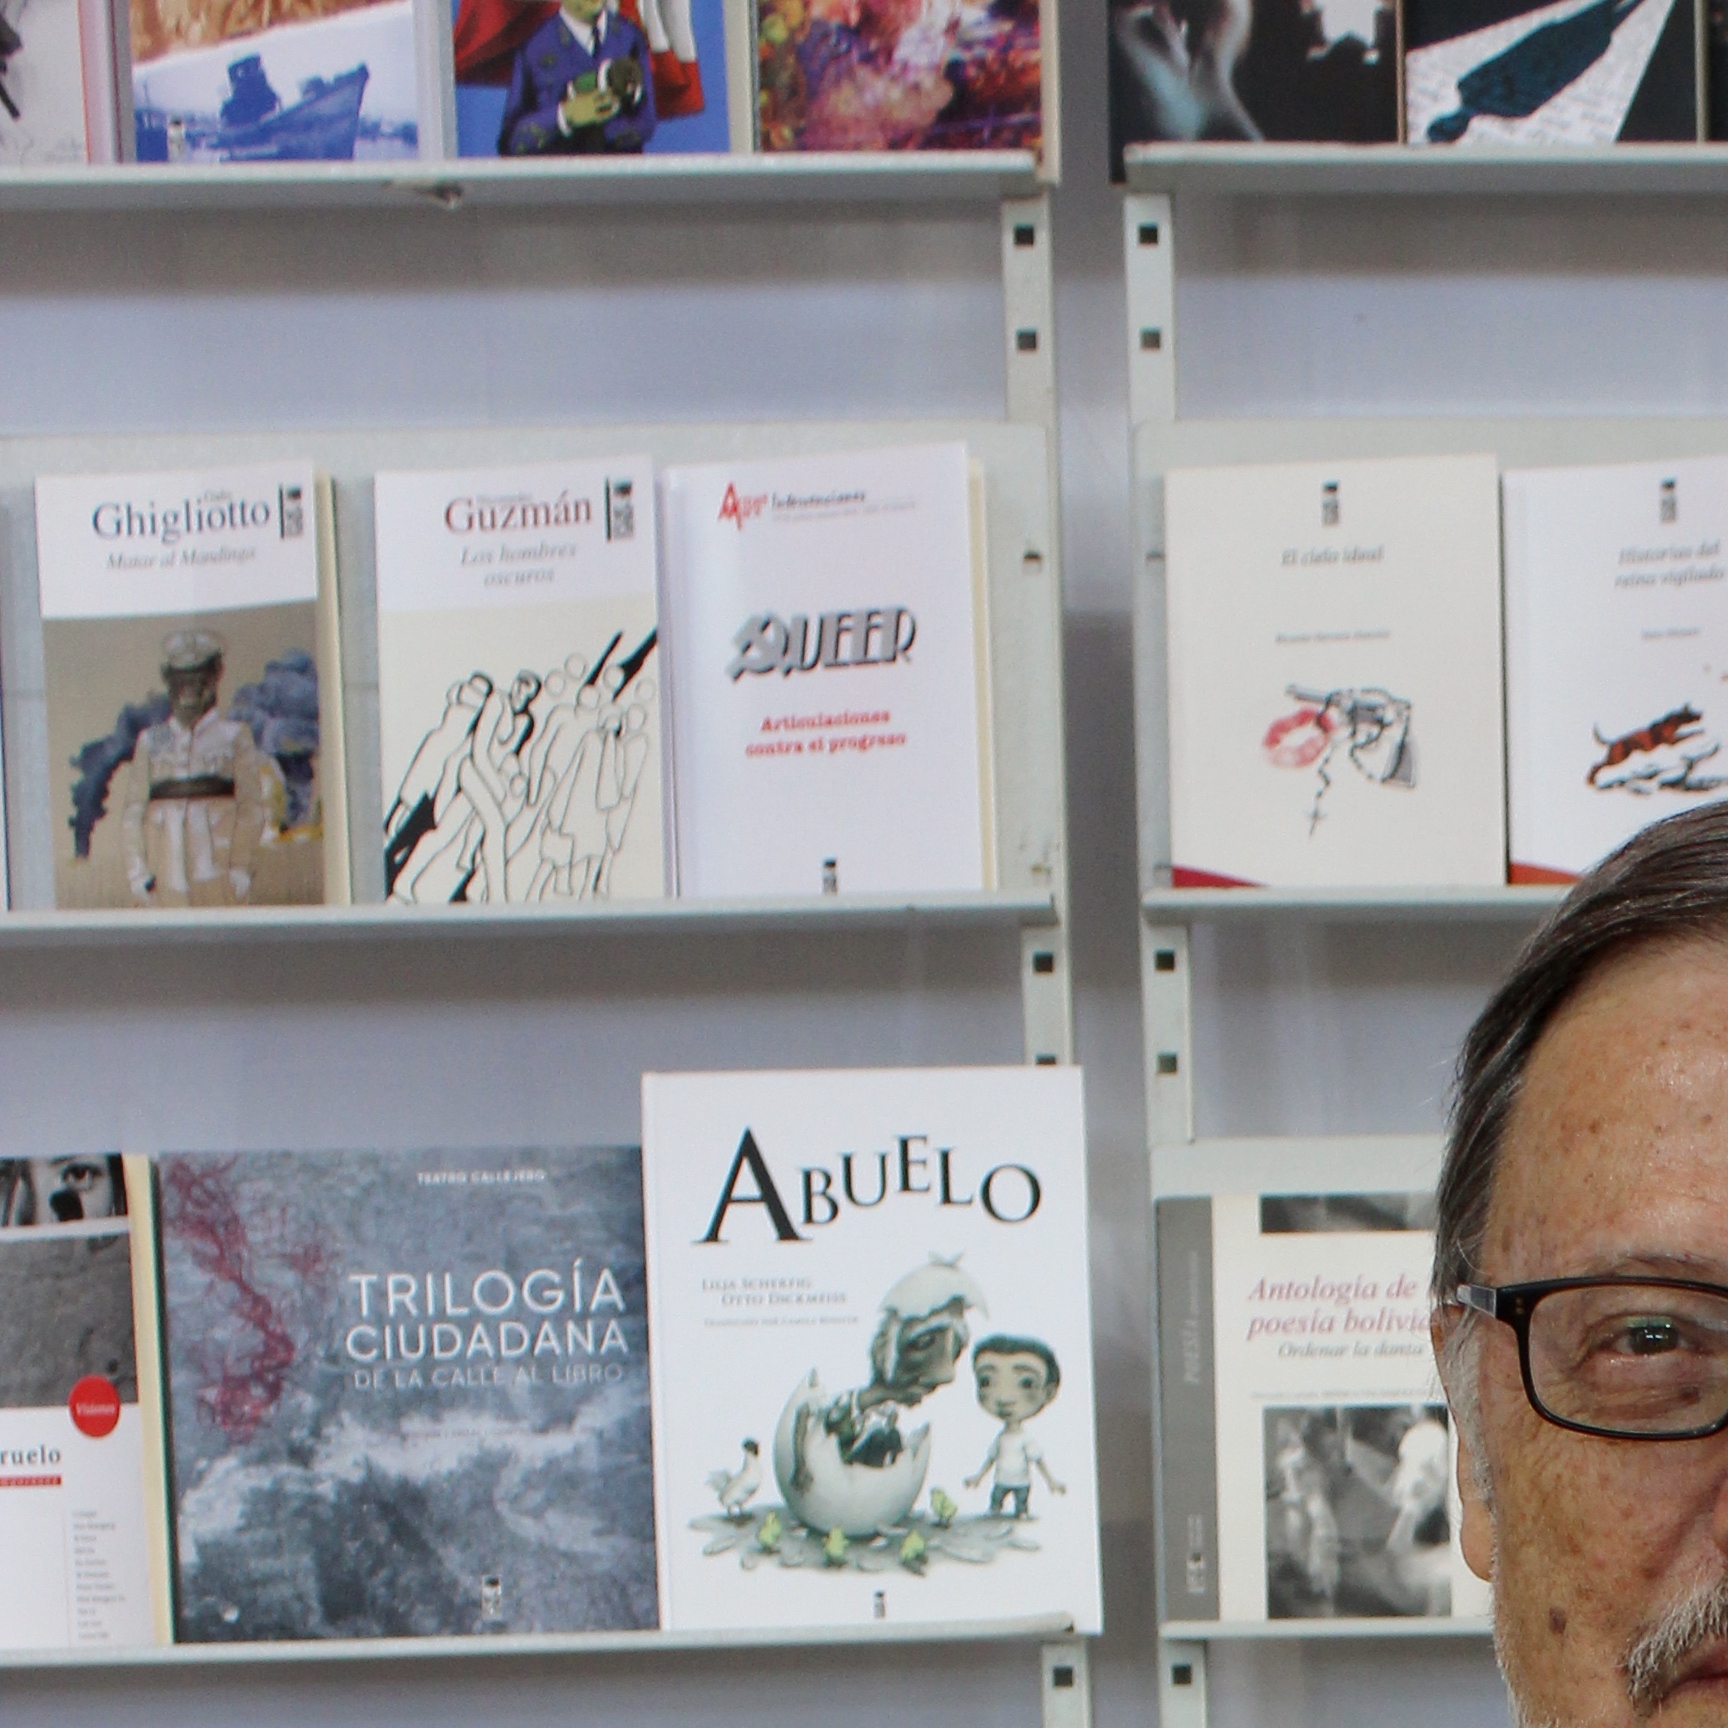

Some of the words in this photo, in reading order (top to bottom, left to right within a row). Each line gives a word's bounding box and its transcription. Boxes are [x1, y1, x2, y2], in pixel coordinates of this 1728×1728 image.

[92, 498, 270, 544] Ghigliotto
[444, 489, 592, 534] Guzmán
[460, 548, 493, 566] Los
[500, 541, 577, 562] hombres
[484, 567, 554, 587] oscuros
[761, 710, 891, 732] Articulaciones
[745, 738, 802, 758] contra
[829, 733, 907, 757] progreso
[417, 1171, 467, 1186] TEATRO
[471, 1168, 547, 1184] CALLEJERO
[690, 1125, 1042, 1244] ABUELO
[348, 1257, 626, 1317] TRILOGÍA
[1247, 1273, 1379, 1306] Antología
[1385, 1272, 1420, 1300] de
[345, 1319, 629, 1363] CIUDADANA
[1246, 1309, 1335, 1341] poesía
[354, 1369, 383, 1390] DE
[395, 1368, 423, 1390] LA
[432, 1365, 506, 1388] CALLE
[514, 1365, 543, 1386] AL
[552, 1362, 623, 1386] LIBRO
